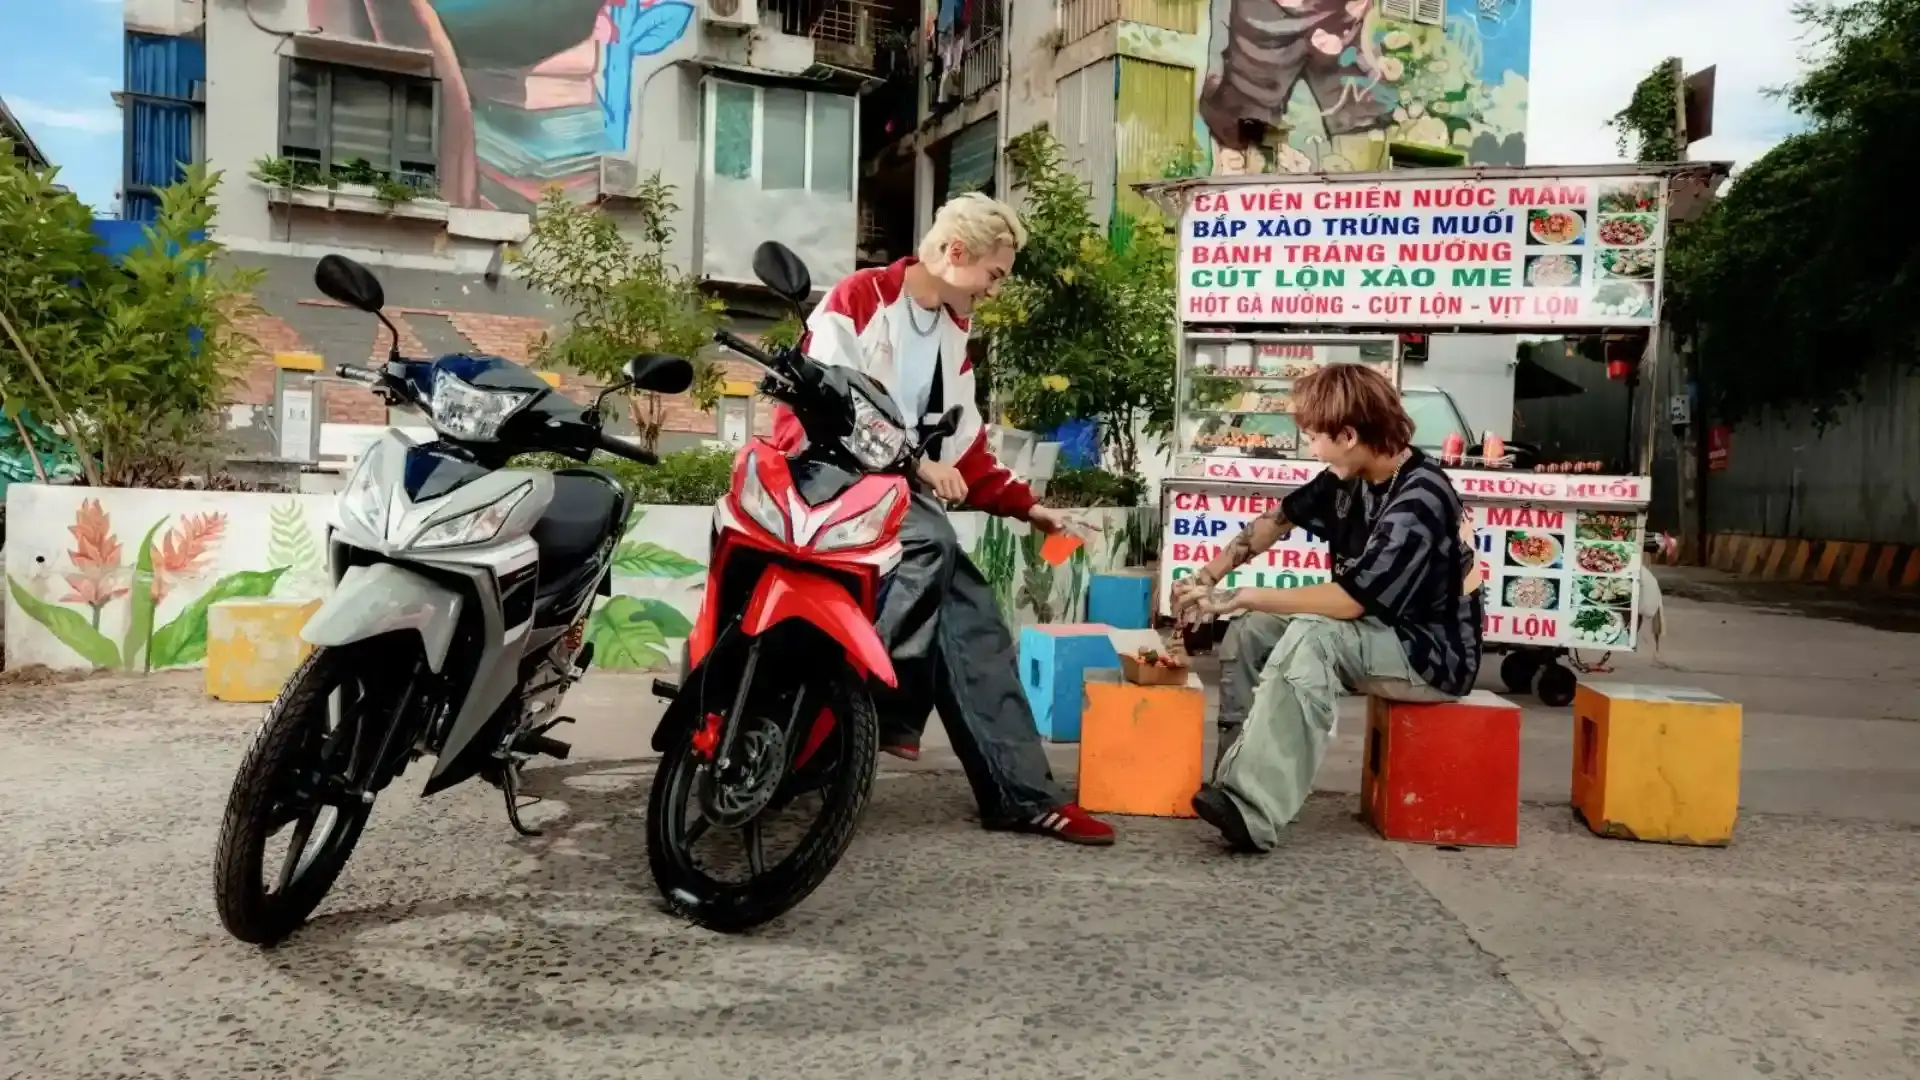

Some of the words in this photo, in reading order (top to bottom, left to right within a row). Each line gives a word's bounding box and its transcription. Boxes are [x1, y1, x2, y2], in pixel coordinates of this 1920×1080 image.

[1240, 188, 1303, 211] VIÊN
[1314, 187, 1401, 209] CHIÊN
[1192, 214, 1247, 238] BẮP
[1256, 215, 1312, 237] XÀO
[1322, 212, 1420, 236] TRỨNG
[1432, 208, 1514, 234] MUỐI
[1191, 241, 1272, 264] BÁNH
[1191, 266, 1262, 288] CÚT
[1275, 265, 1345, 291] LỘN
[1360, 264, 1436, 288] XÀO
[1452, 267, 1512, 287] ME
[1237, 292, 1264, 314] GÀ
[1368, 292, 1412, 315] CÚT
[1420, 292, 1461, 318] LỘN
[1489, 295, 1525, 319] VỊT
[1461, 476, 1557, 496] TRỨNG
[1566, 478, 1641, 498] MUỐI
[1175, 489, 1210, 512] CÁ
[1174, 513, 1227, 537] BẮP
[1511, 613, 1557, 640] LỘN
